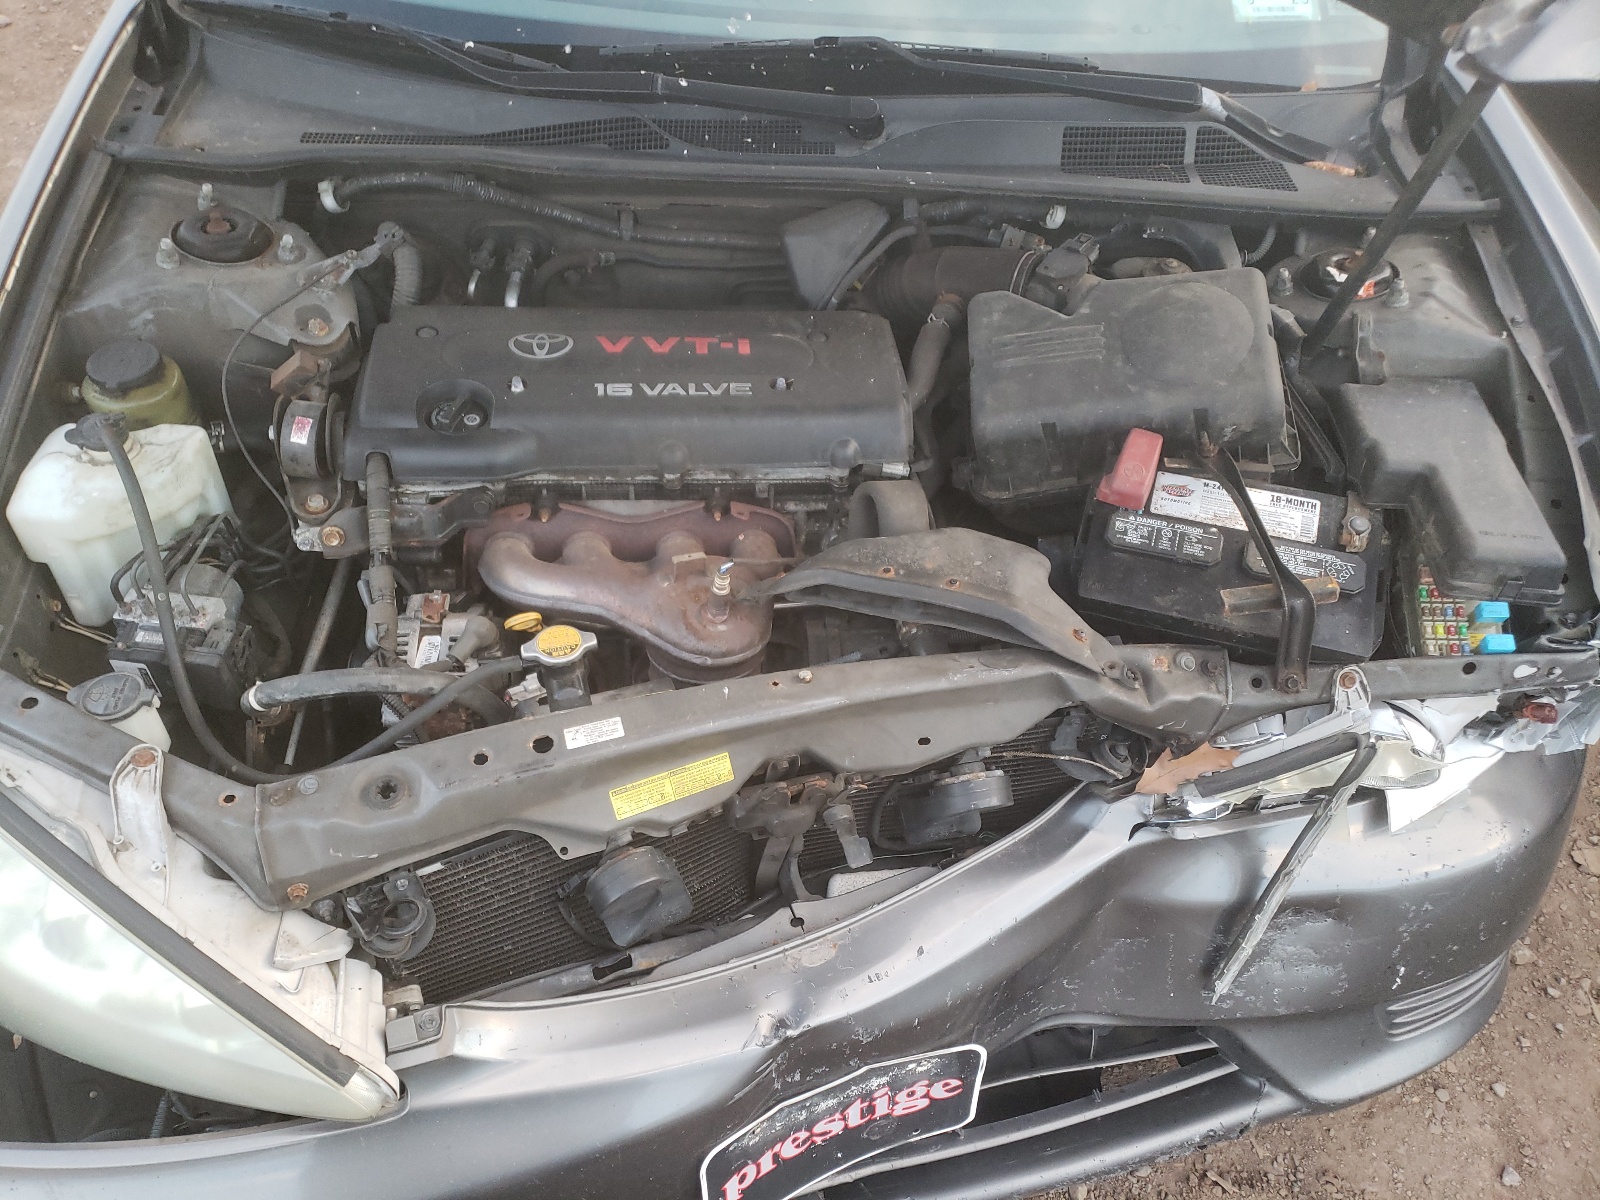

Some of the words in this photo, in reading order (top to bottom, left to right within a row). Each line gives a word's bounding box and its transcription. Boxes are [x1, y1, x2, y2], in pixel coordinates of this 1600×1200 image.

[594, 382, 634, 397] 16
[639, 382, 753, 396] VALVE
[1270, 495, 1318, 511] 18-MONTH
[1136, 516, 1168, 527] DANGER
[1174, 523, 1204, 534] POISON
[721, 1077, 964, 1200] prestige
